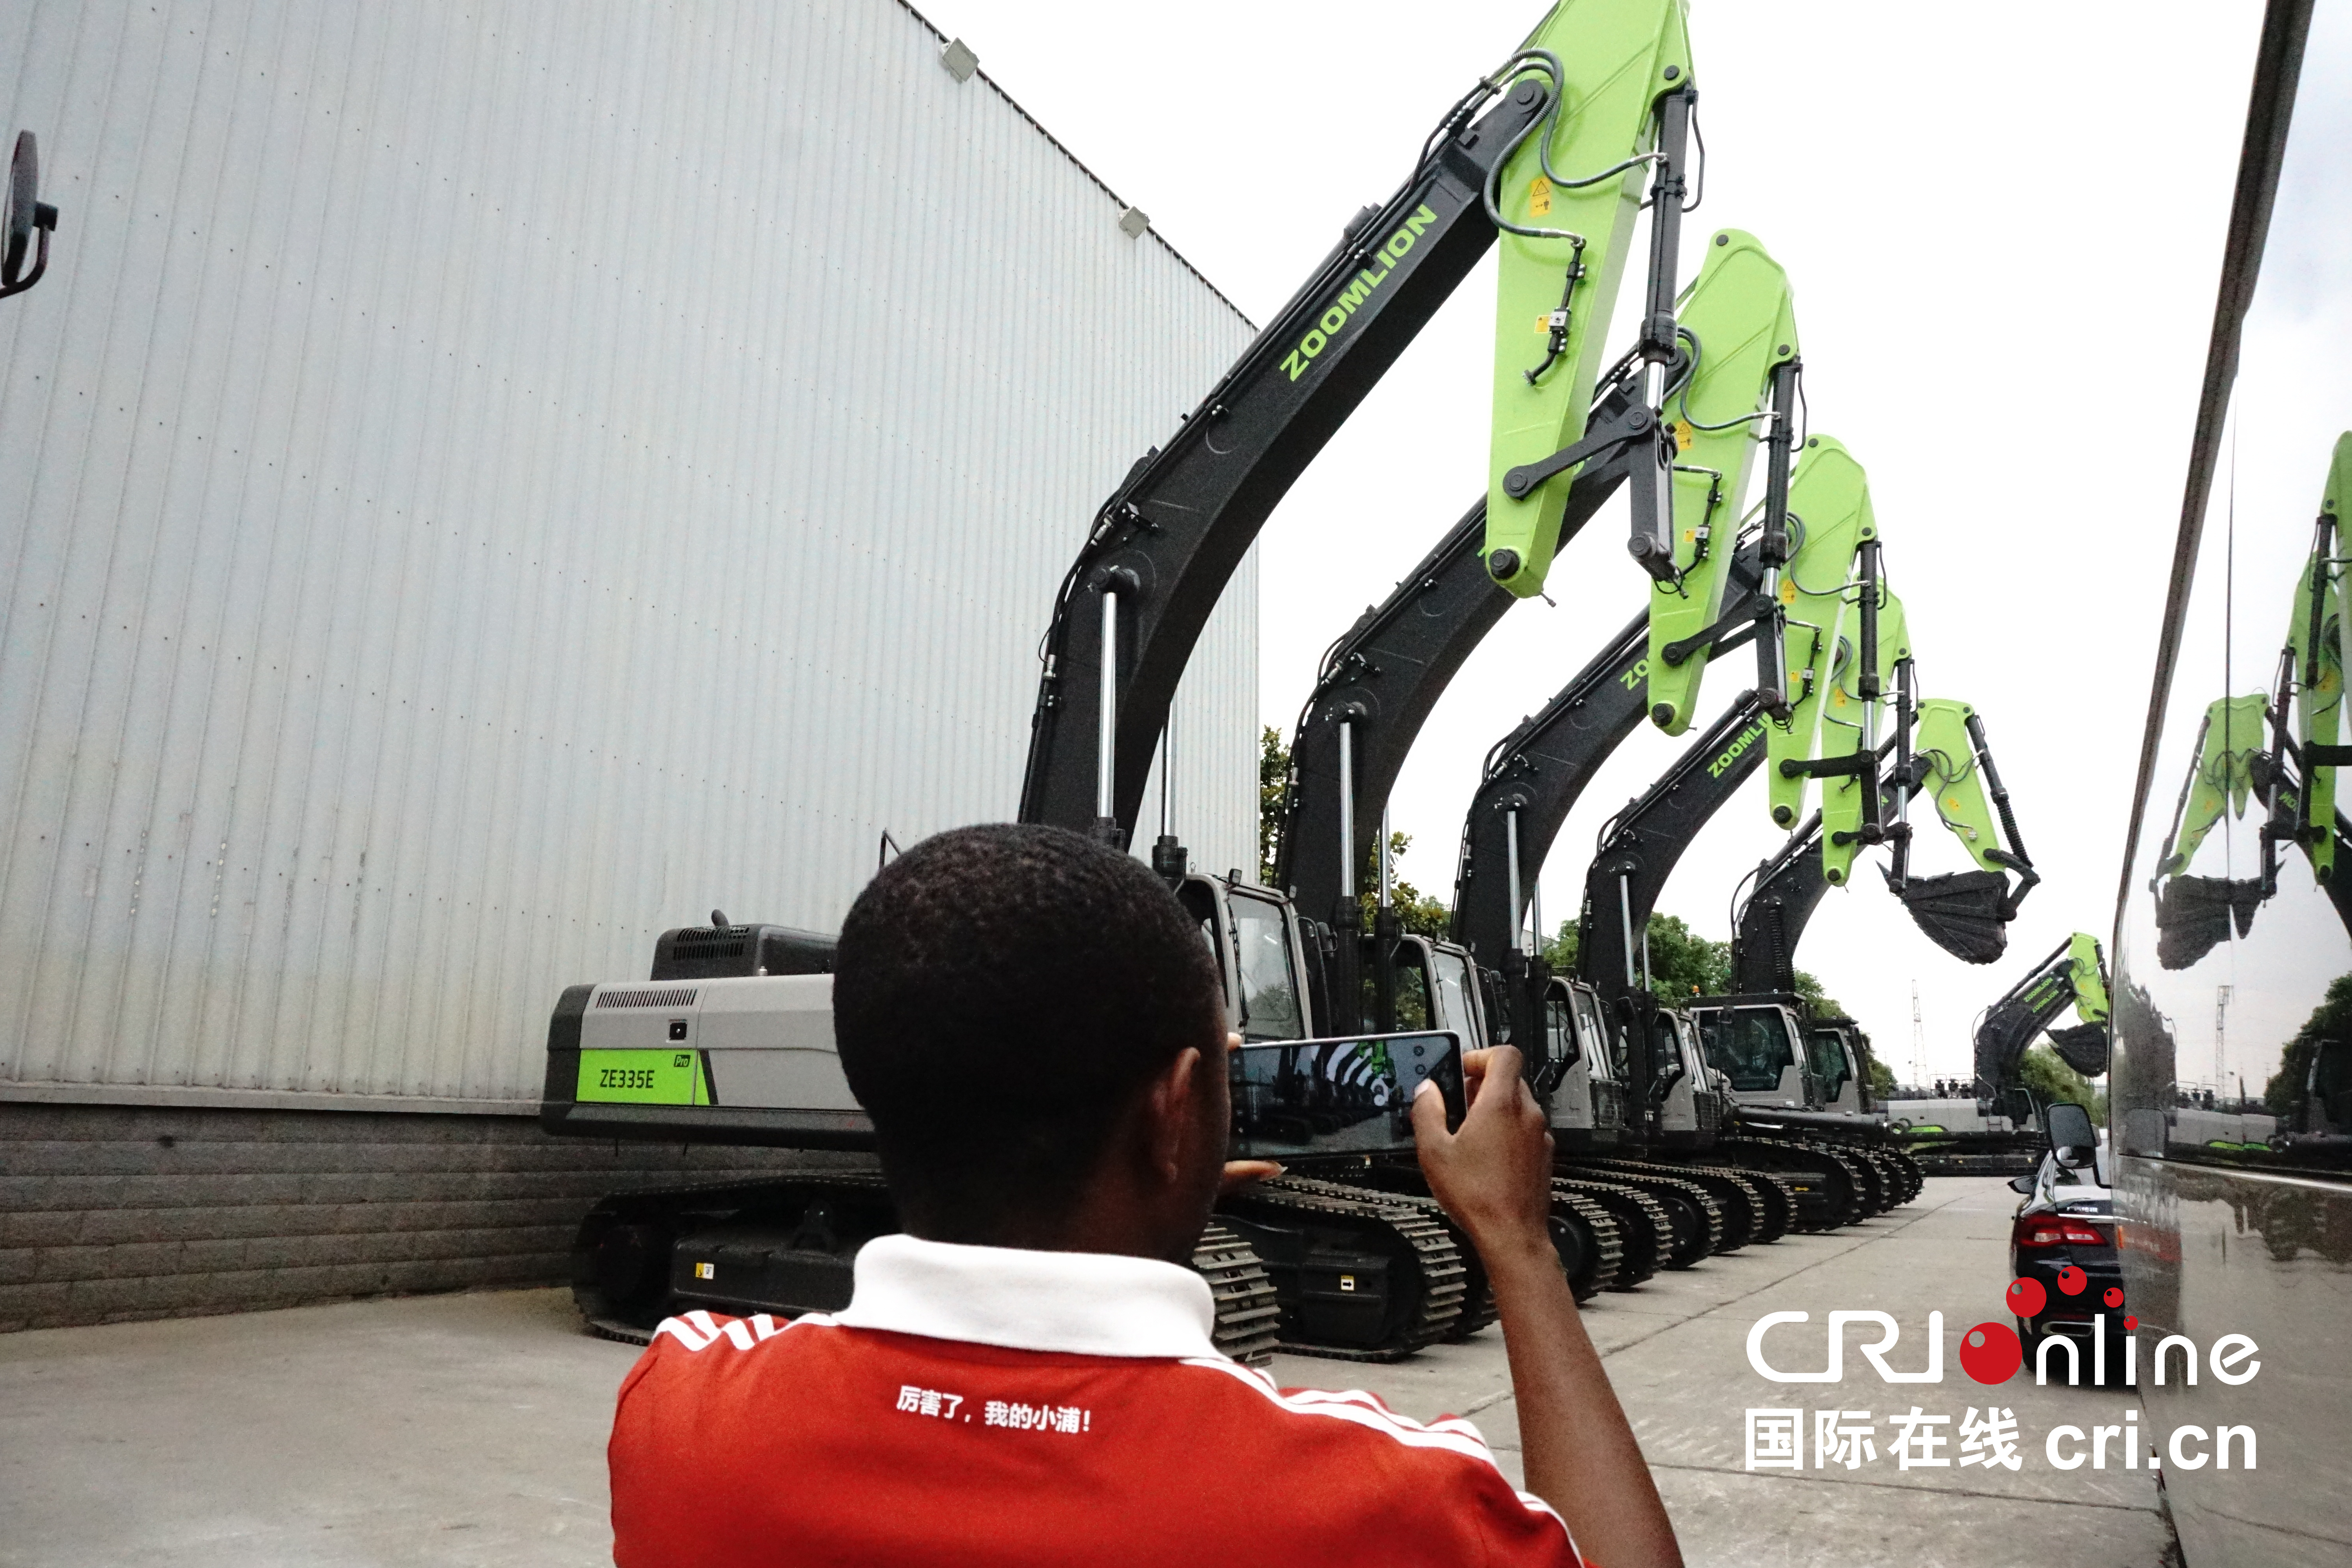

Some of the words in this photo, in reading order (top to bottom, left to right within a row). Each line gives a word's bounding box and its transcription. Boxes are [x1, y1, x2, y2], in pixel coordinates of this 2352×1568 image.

[1279, 204, 1437, 381] ZOOMLION
[2024, 977, 2053, 1002] ZOOMLION
[2033, 989, 2059, 1013] ZOOMLION
[675, 1056, 689, 1067] Pro
[600, 1069, 655, 1088] ZE335E
